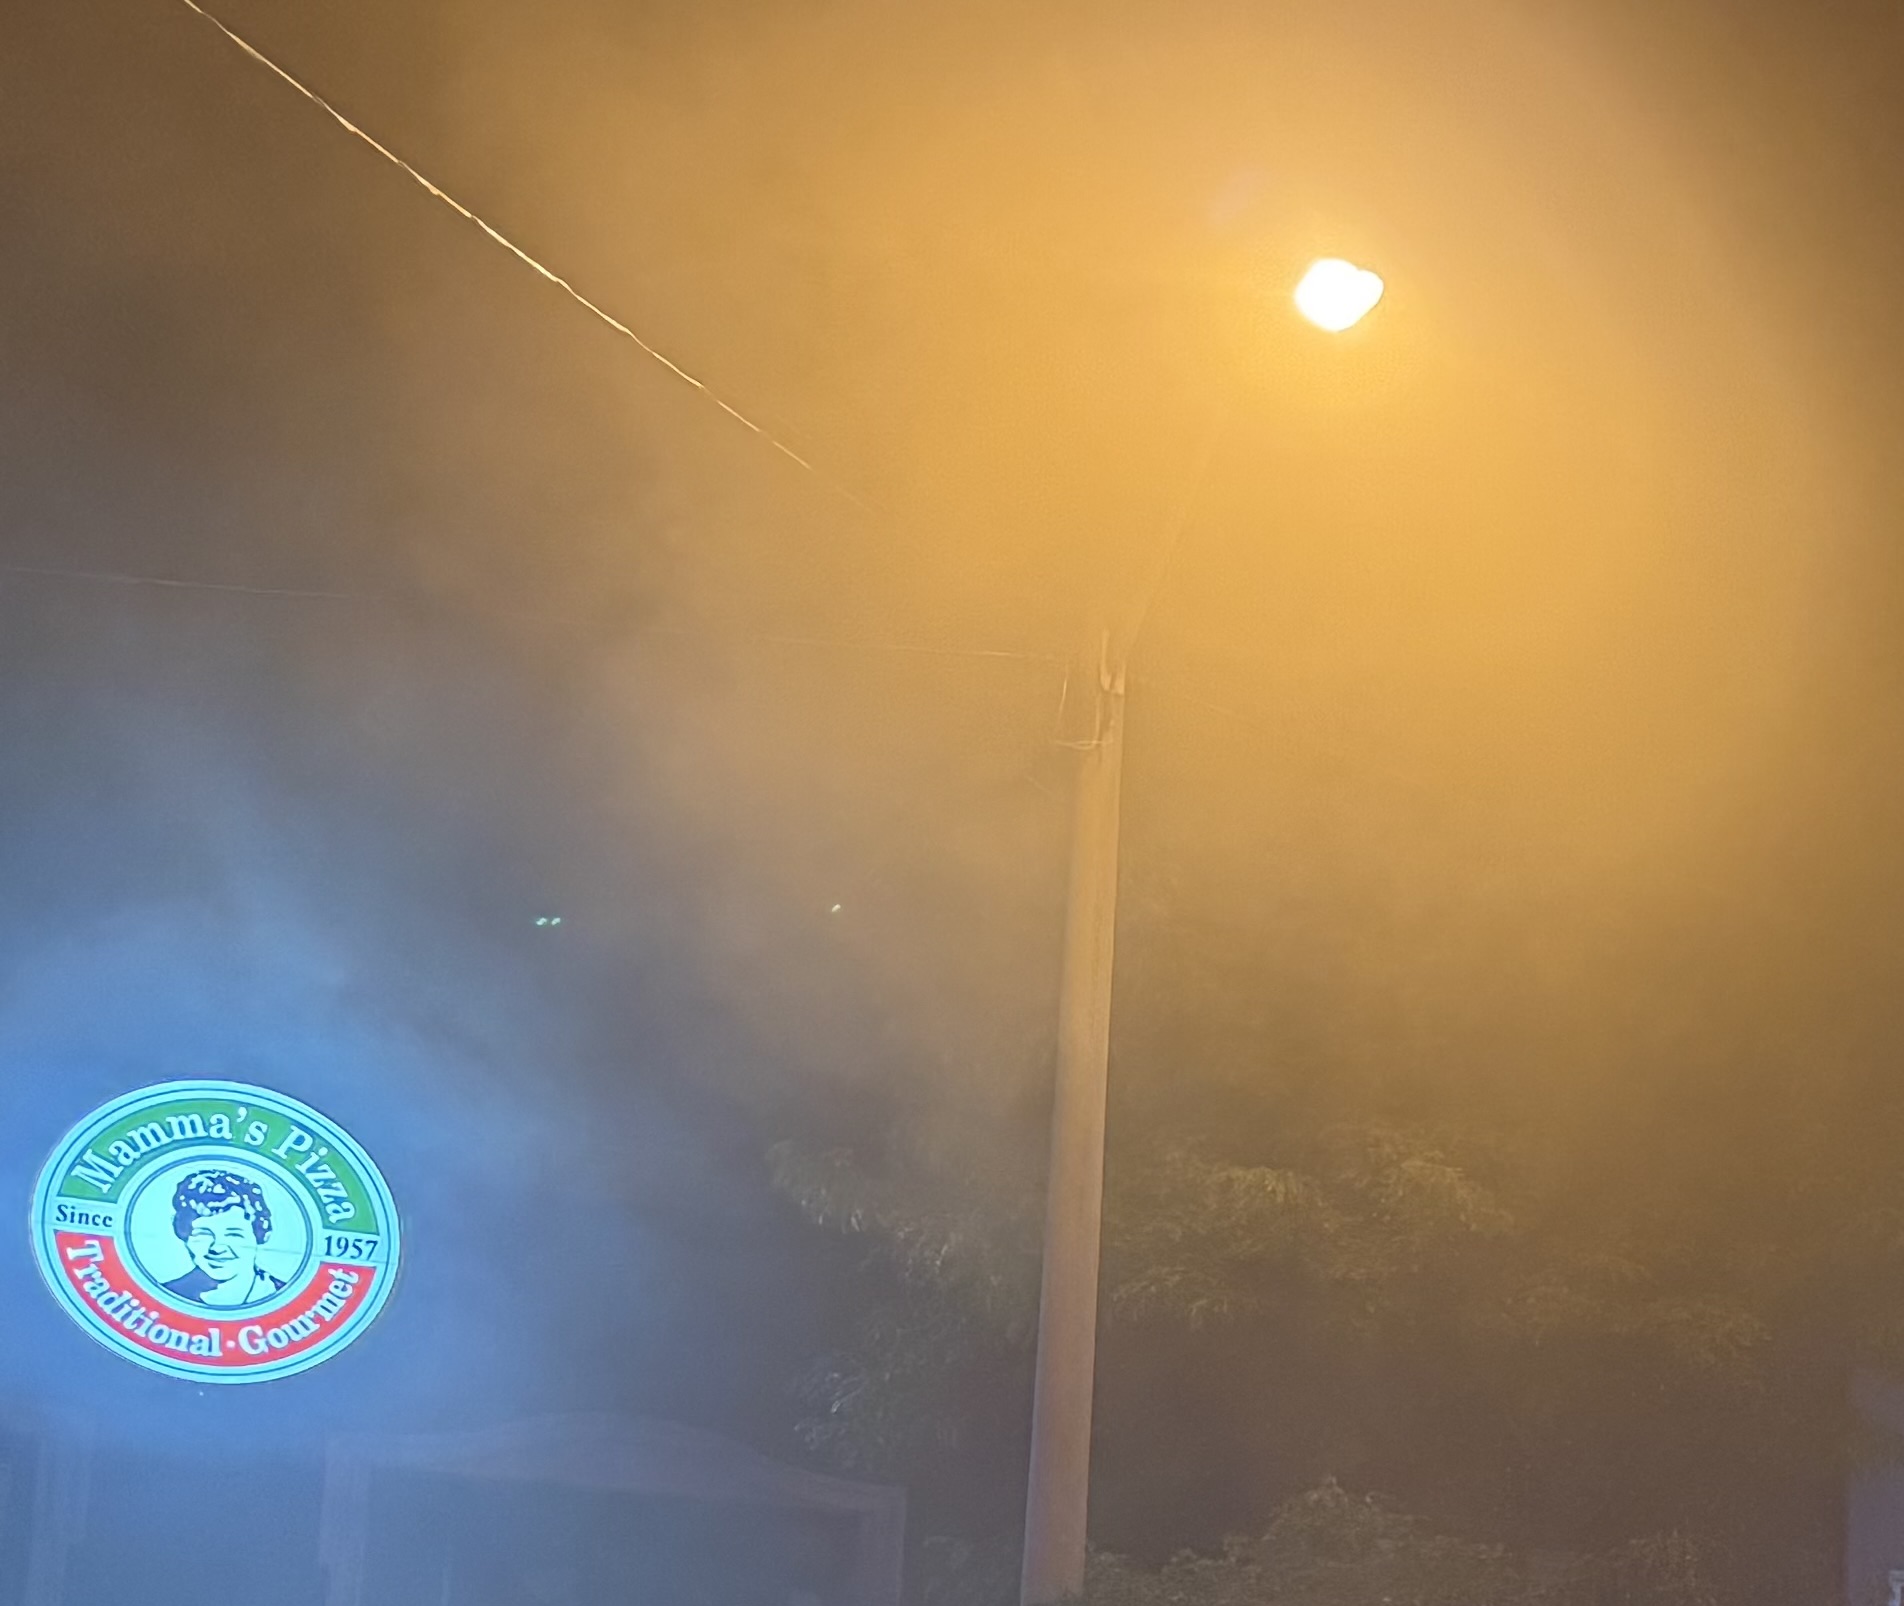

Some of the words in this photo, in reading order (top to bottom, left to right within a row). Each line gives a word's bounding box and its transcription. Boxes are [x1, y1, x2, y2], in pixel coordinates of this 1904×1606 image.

[70, 1106, 269, 1194] Mamma's
[272, 1125, 357, 1224] Pizza
[56, 1204, 114, 1228] Since
[323, 1235, 380, 1261] 1957
[66, 1239, 224, 1358] Traditional
[238, 1268, 360, 1355] Gourmet
